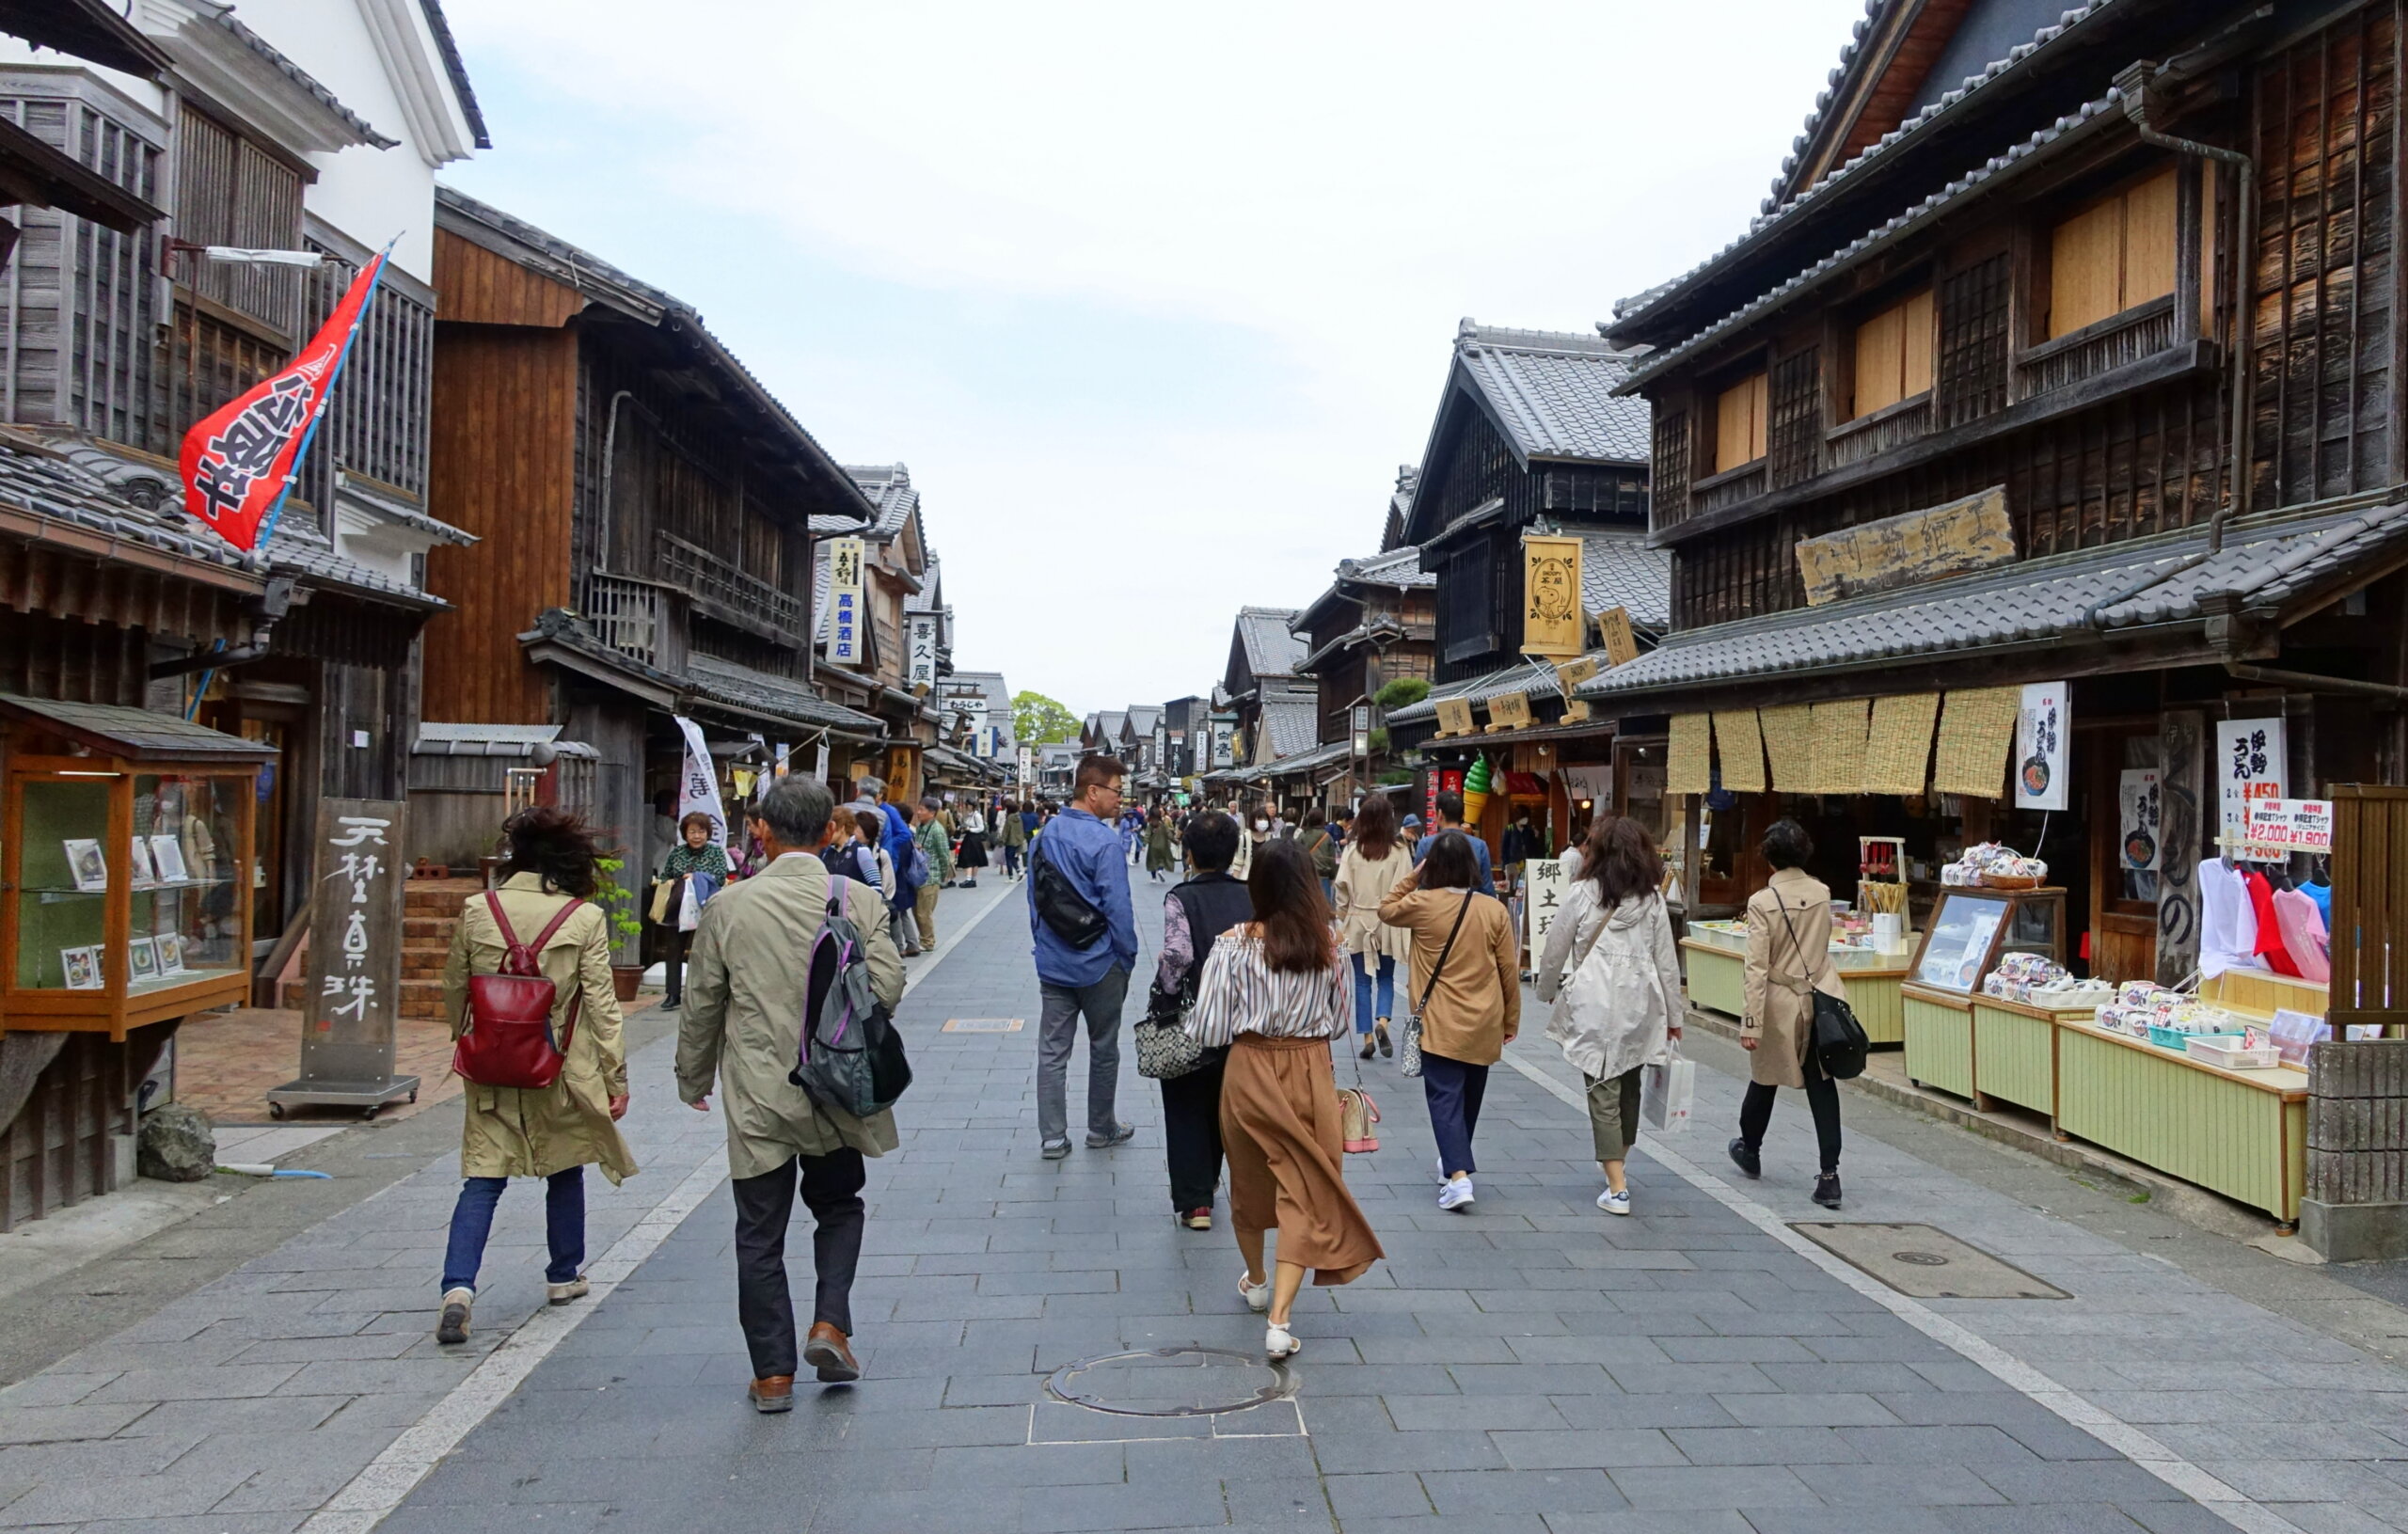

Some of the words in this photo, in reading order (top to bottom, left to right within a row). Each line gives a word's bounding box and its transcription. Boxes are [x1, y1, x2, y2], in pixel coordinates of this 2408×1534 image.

[1541, 577, 1563, 585] 茶屋
[911, 623, 932, 682] 喜久屋
[949, 700, 984, 709] わらじや
[2035, 720, 2047, 764] うどん
[2233, 737, 2251, 780] うどん
[2250, 729, 2268, 775] 伊勢
